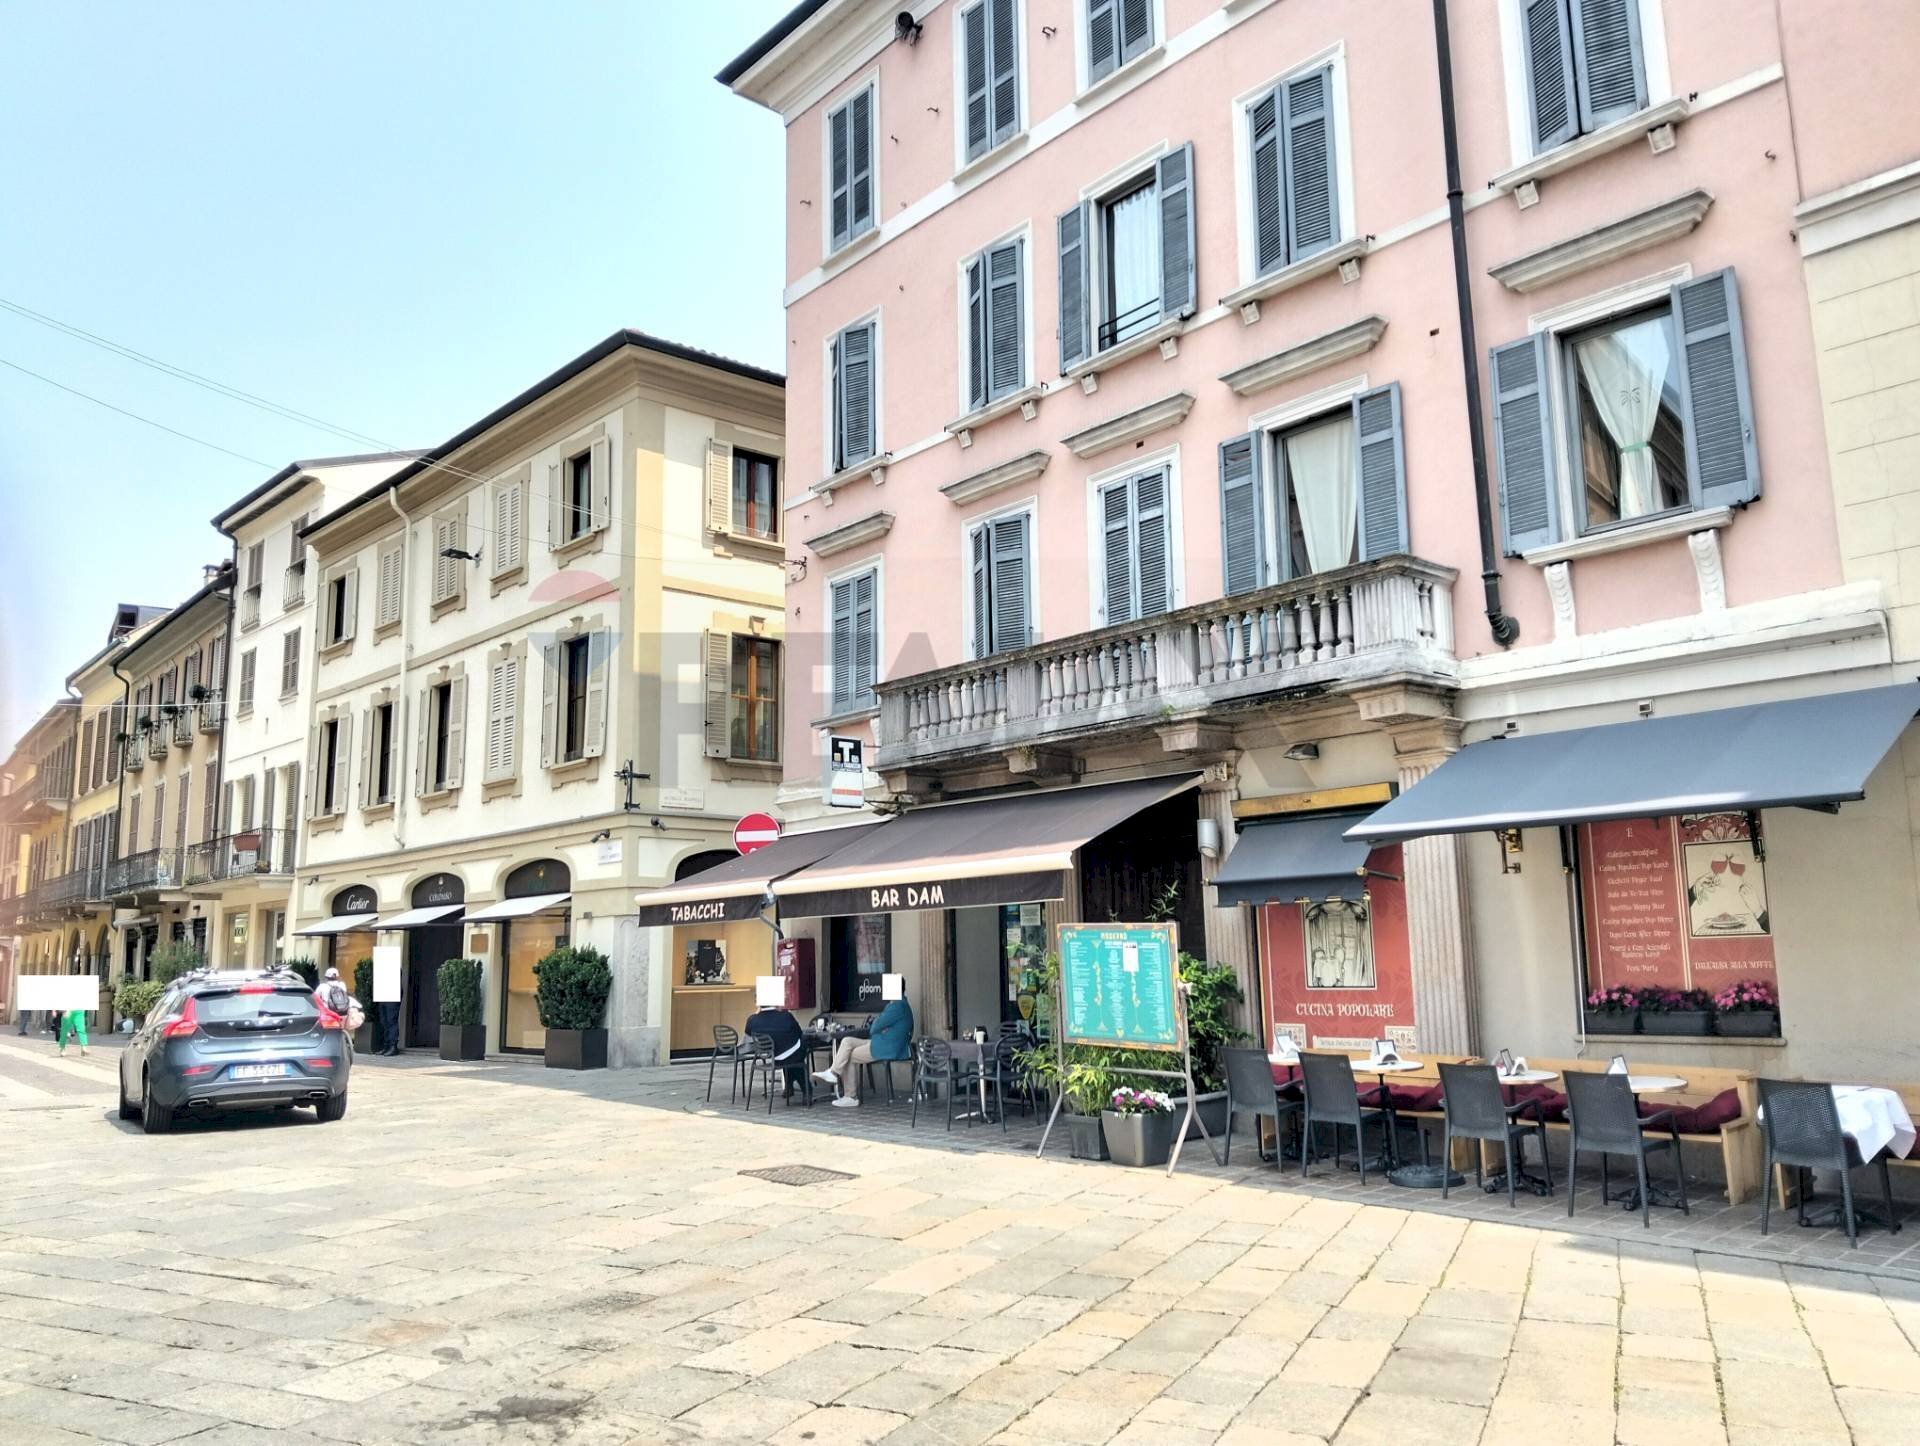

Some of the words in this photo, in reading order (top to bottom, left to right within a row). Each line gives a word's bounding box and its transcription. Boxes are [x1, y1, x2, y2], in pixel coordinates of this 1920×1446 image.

[838, 741, 854, 762] T
[346, 894, 370, 911] Cartier
[871, 889, 900, 909] BAR
[907, 885, 944, 907] DAM
[670, 901, 725, 921] TABACCHI
[858, 978, 882, 1002] ploom
[1295, 1002, 1334, 1016] CUCINA
[1336, 1003, 1395, 1018] POPOLARE
